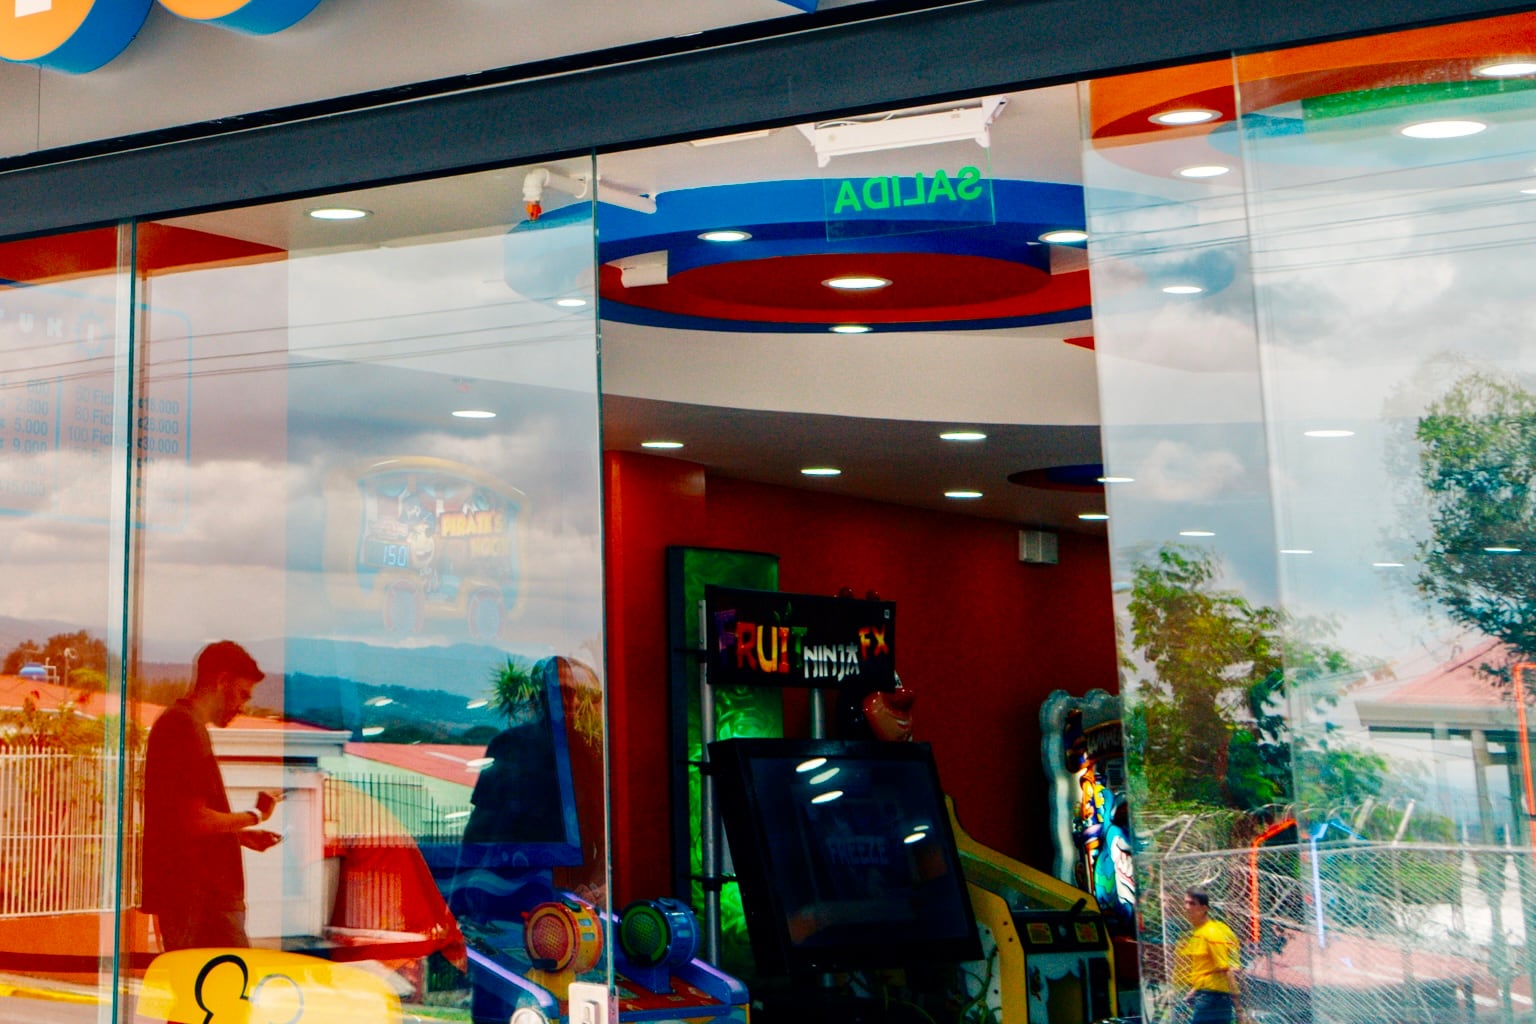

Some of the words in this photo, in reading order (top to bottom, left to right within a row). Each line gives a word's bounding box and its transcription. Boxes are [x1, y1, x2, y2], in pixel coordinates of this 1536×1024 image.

[383, 544, 408, 567] 150
[714, 609, 809, 672] FRUIT
[803, 643, 860, 681] NINJA
[858, 624, 889, 661] FX
